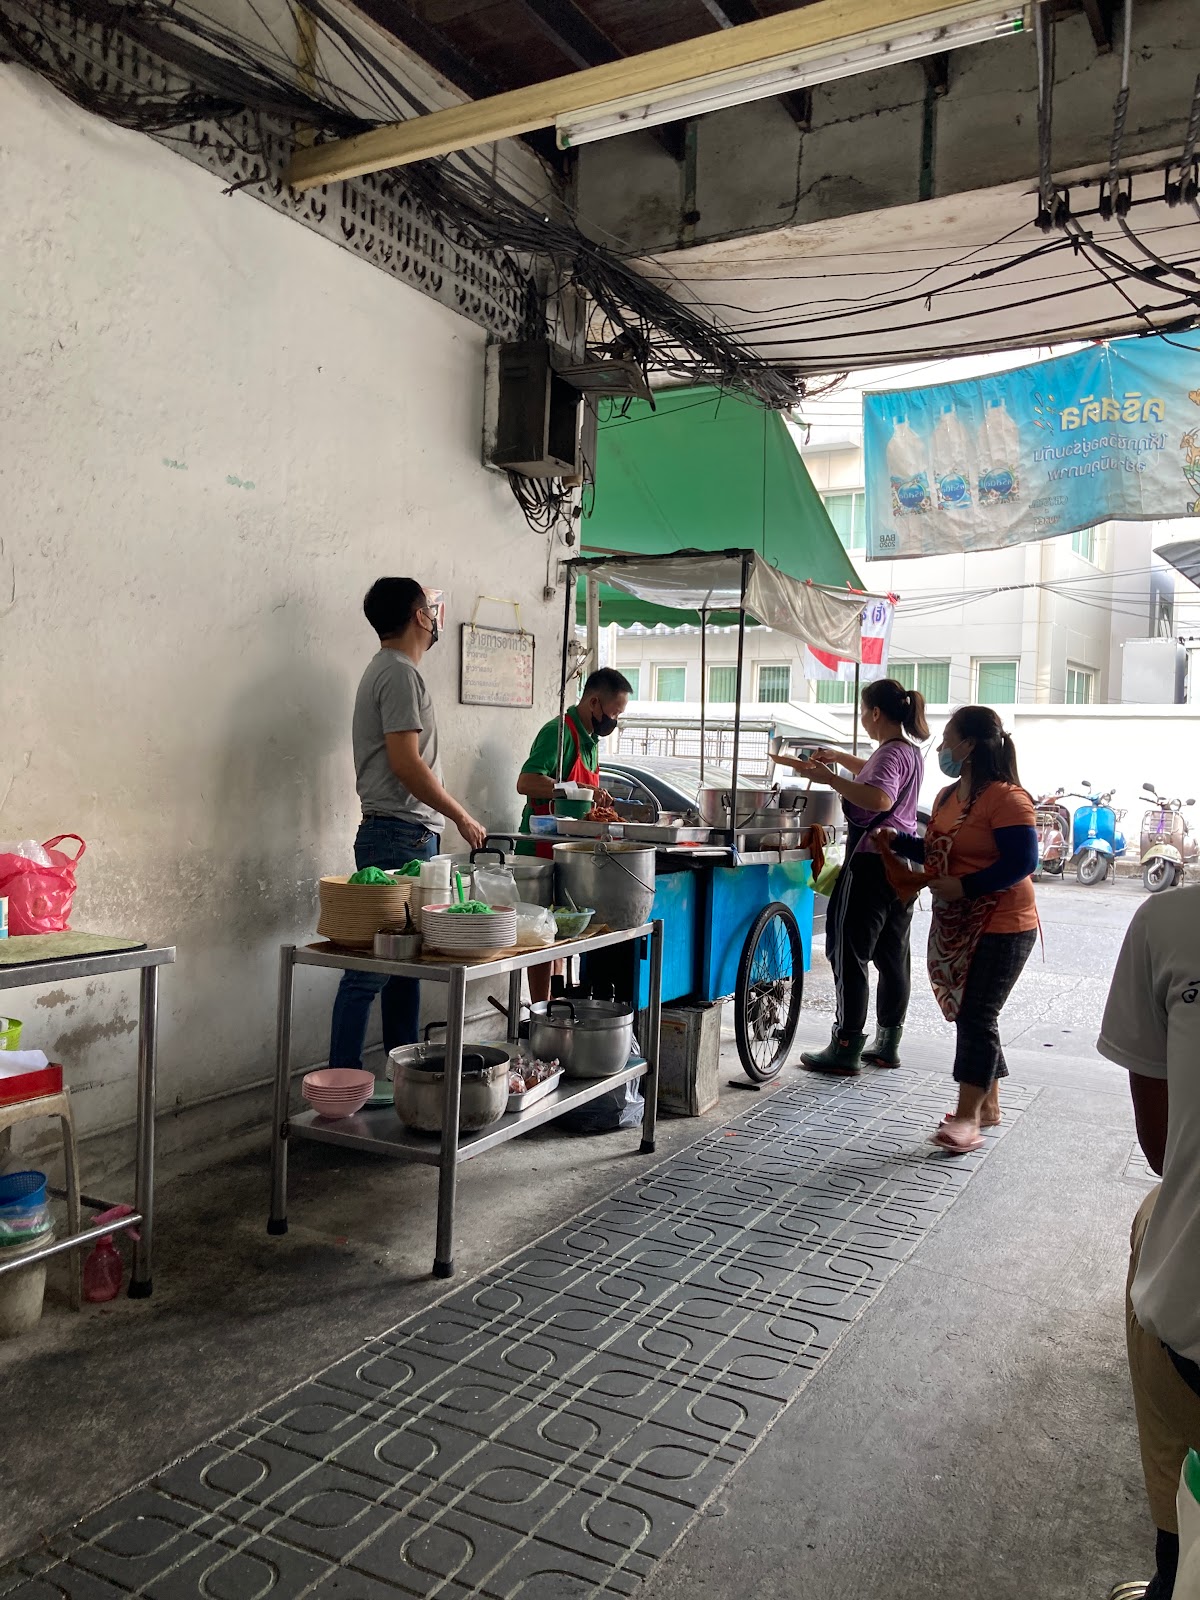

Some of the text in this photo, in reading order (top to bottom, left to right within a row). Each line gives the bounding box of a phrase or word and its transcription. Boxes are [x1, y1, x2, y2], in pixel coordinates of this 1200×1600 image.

[470, 631, 527, 652] รายการอาหาร
